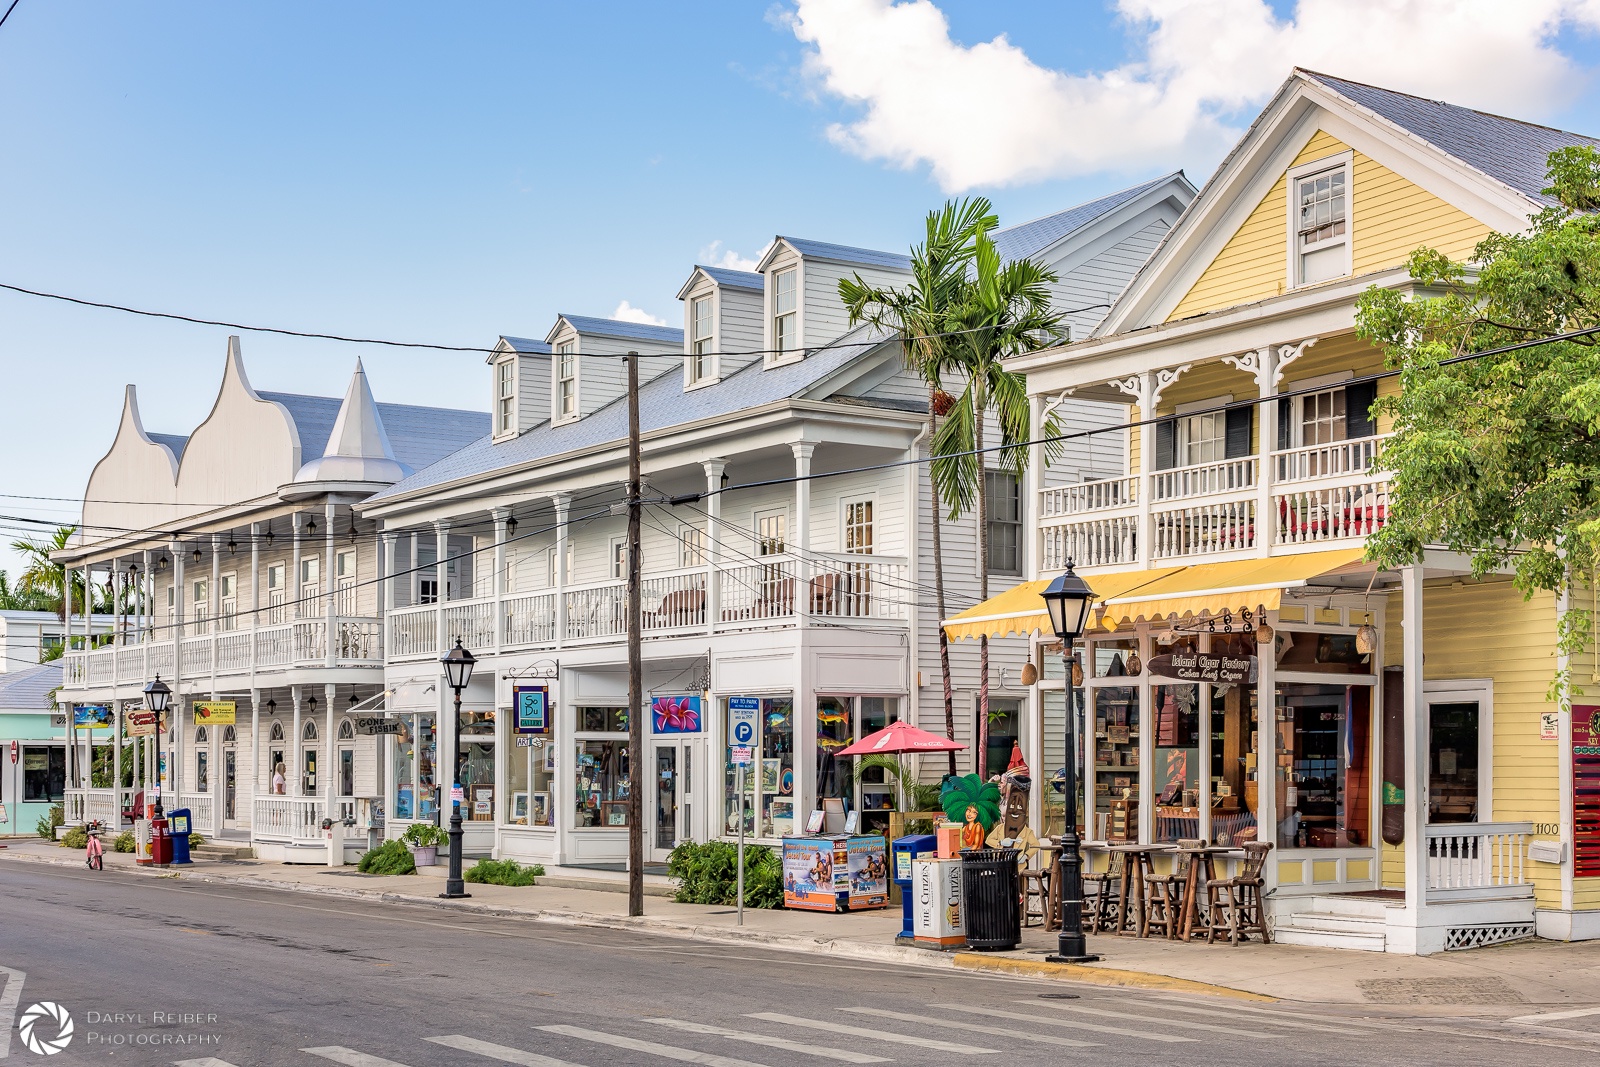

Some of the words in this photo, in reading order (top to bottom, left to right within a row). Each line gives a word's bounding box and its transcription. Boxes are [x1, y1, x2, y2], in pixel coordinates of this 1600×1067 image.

[1172, 654, 1197, 667] Island
[1198, 655, 1220, 670] Cigar
[1221, 656, 1251, 672] Factory
[1177, 668, 1199, 678] Cuban
[1201, 668, 1218, 682] Leaf
[1219, 669, 1243, 682] Cigars
[524, 695, 538, 706] So
[525, 704, 538, 716] Du
[359, 718, 385, 727] GONE
[1536, 823, 1559, 835] 1100
[800, 852, 811, 860] Tour
[952, 910, 960, 930] THE
